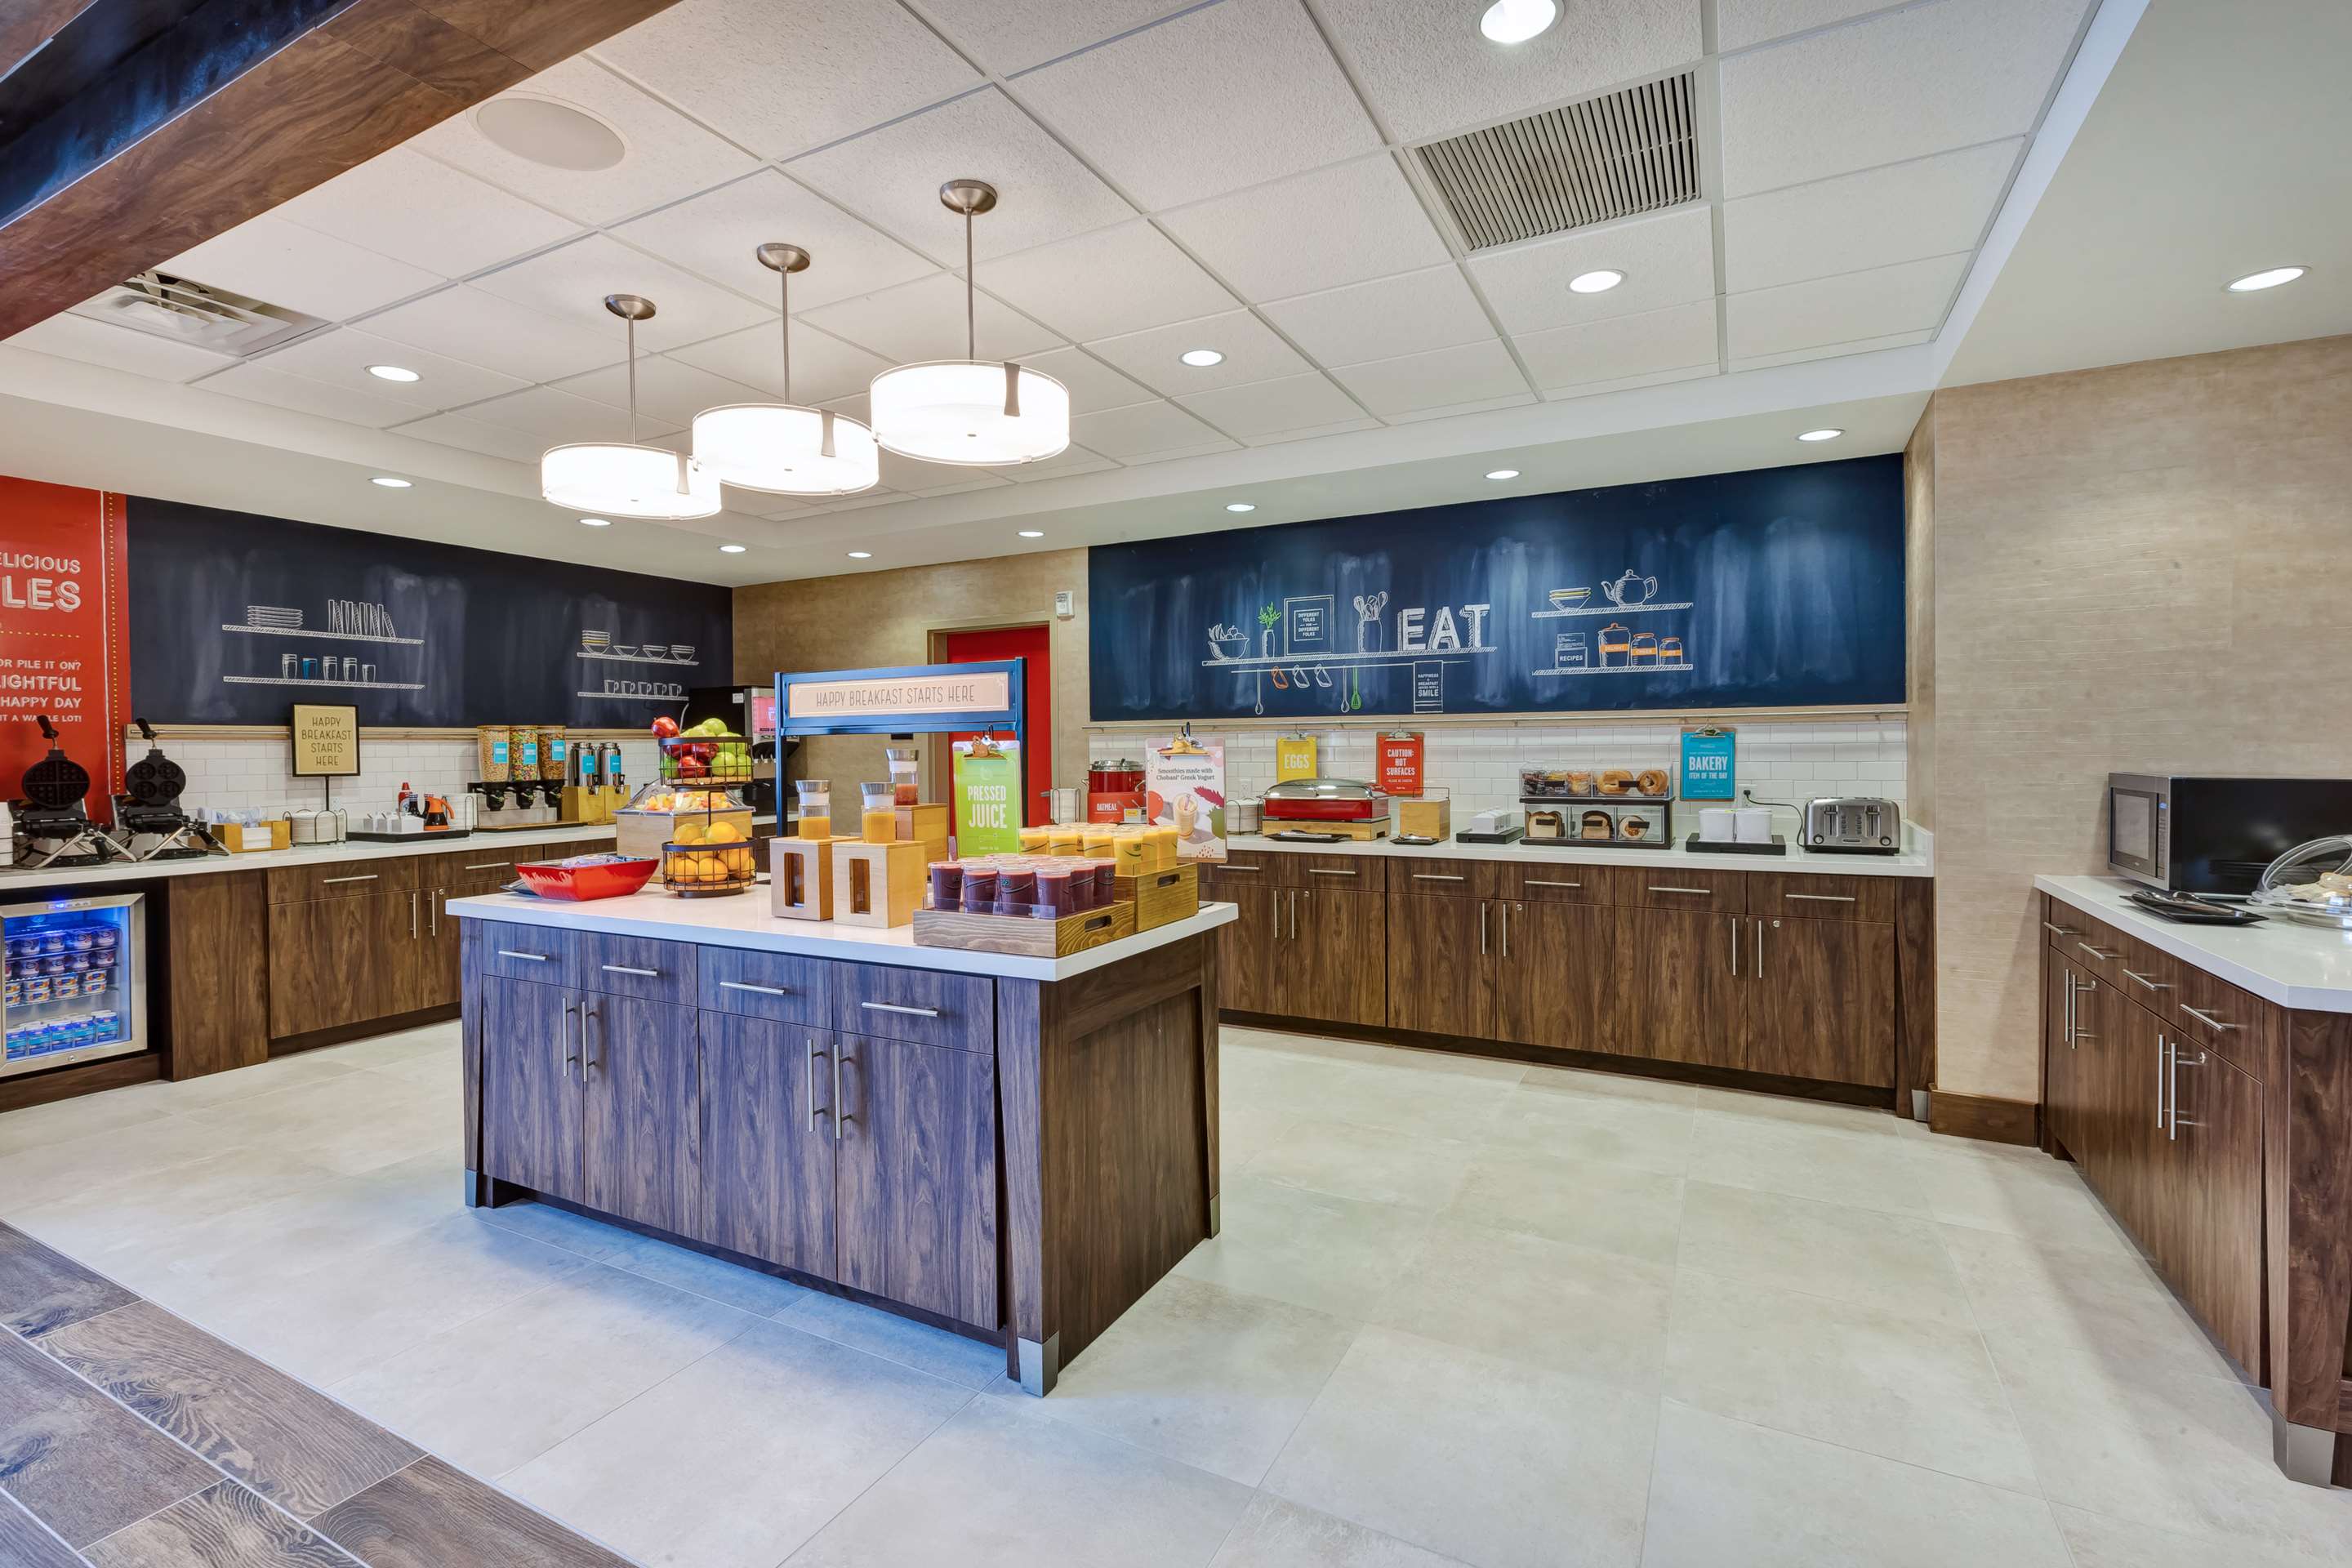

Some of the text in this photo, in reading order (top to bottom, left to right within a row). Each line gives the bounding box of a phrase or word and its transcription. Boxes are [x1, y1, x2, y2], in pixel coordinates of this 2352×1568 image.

[0, 552, 81, 574] LICIOUS
[2, 575, 81, 612] LES
[1397, 604, 1490, 652] EAT
[16, 659, 42, 670] PILE
[45, 661, 56, 670] IT
[60, 660, 82, 670] ON?
[0, 674, 82, 692] IGHTFUL
[817, 684, 975, 707] HAPPY BREAKFAST STARTS HERE
[1418, 689, 1439, 697] SMILE
[54, 697, 82, 709] DAY
[22, 715, 59, 723] WALE
[312, 716, 341, 727] HAPPY
[301, 729, 352, 740] BREAKFAST
[310, 742, 343, 753] STARTS
[1388, 748, 1414, 758] CAUTION:
[315, 755, 340, 766] HERE
[1284, 754, 1310, 770] EGGS
[1395, 758, 1407, 767] HOT
[1688, 756, 1728, 771] BAKERY
[1386, 767, 1415, 776] SURFACES
[1688, 772, 1728, 780] ITEM OF THE DAY
[1197, 773, 1215, 782] Yogurt
[967, 785, 1007, 801] PRESSED
[1096, 803, 1118, 812] OATMEAL
[969, 803, 1008, 829] JUICE
